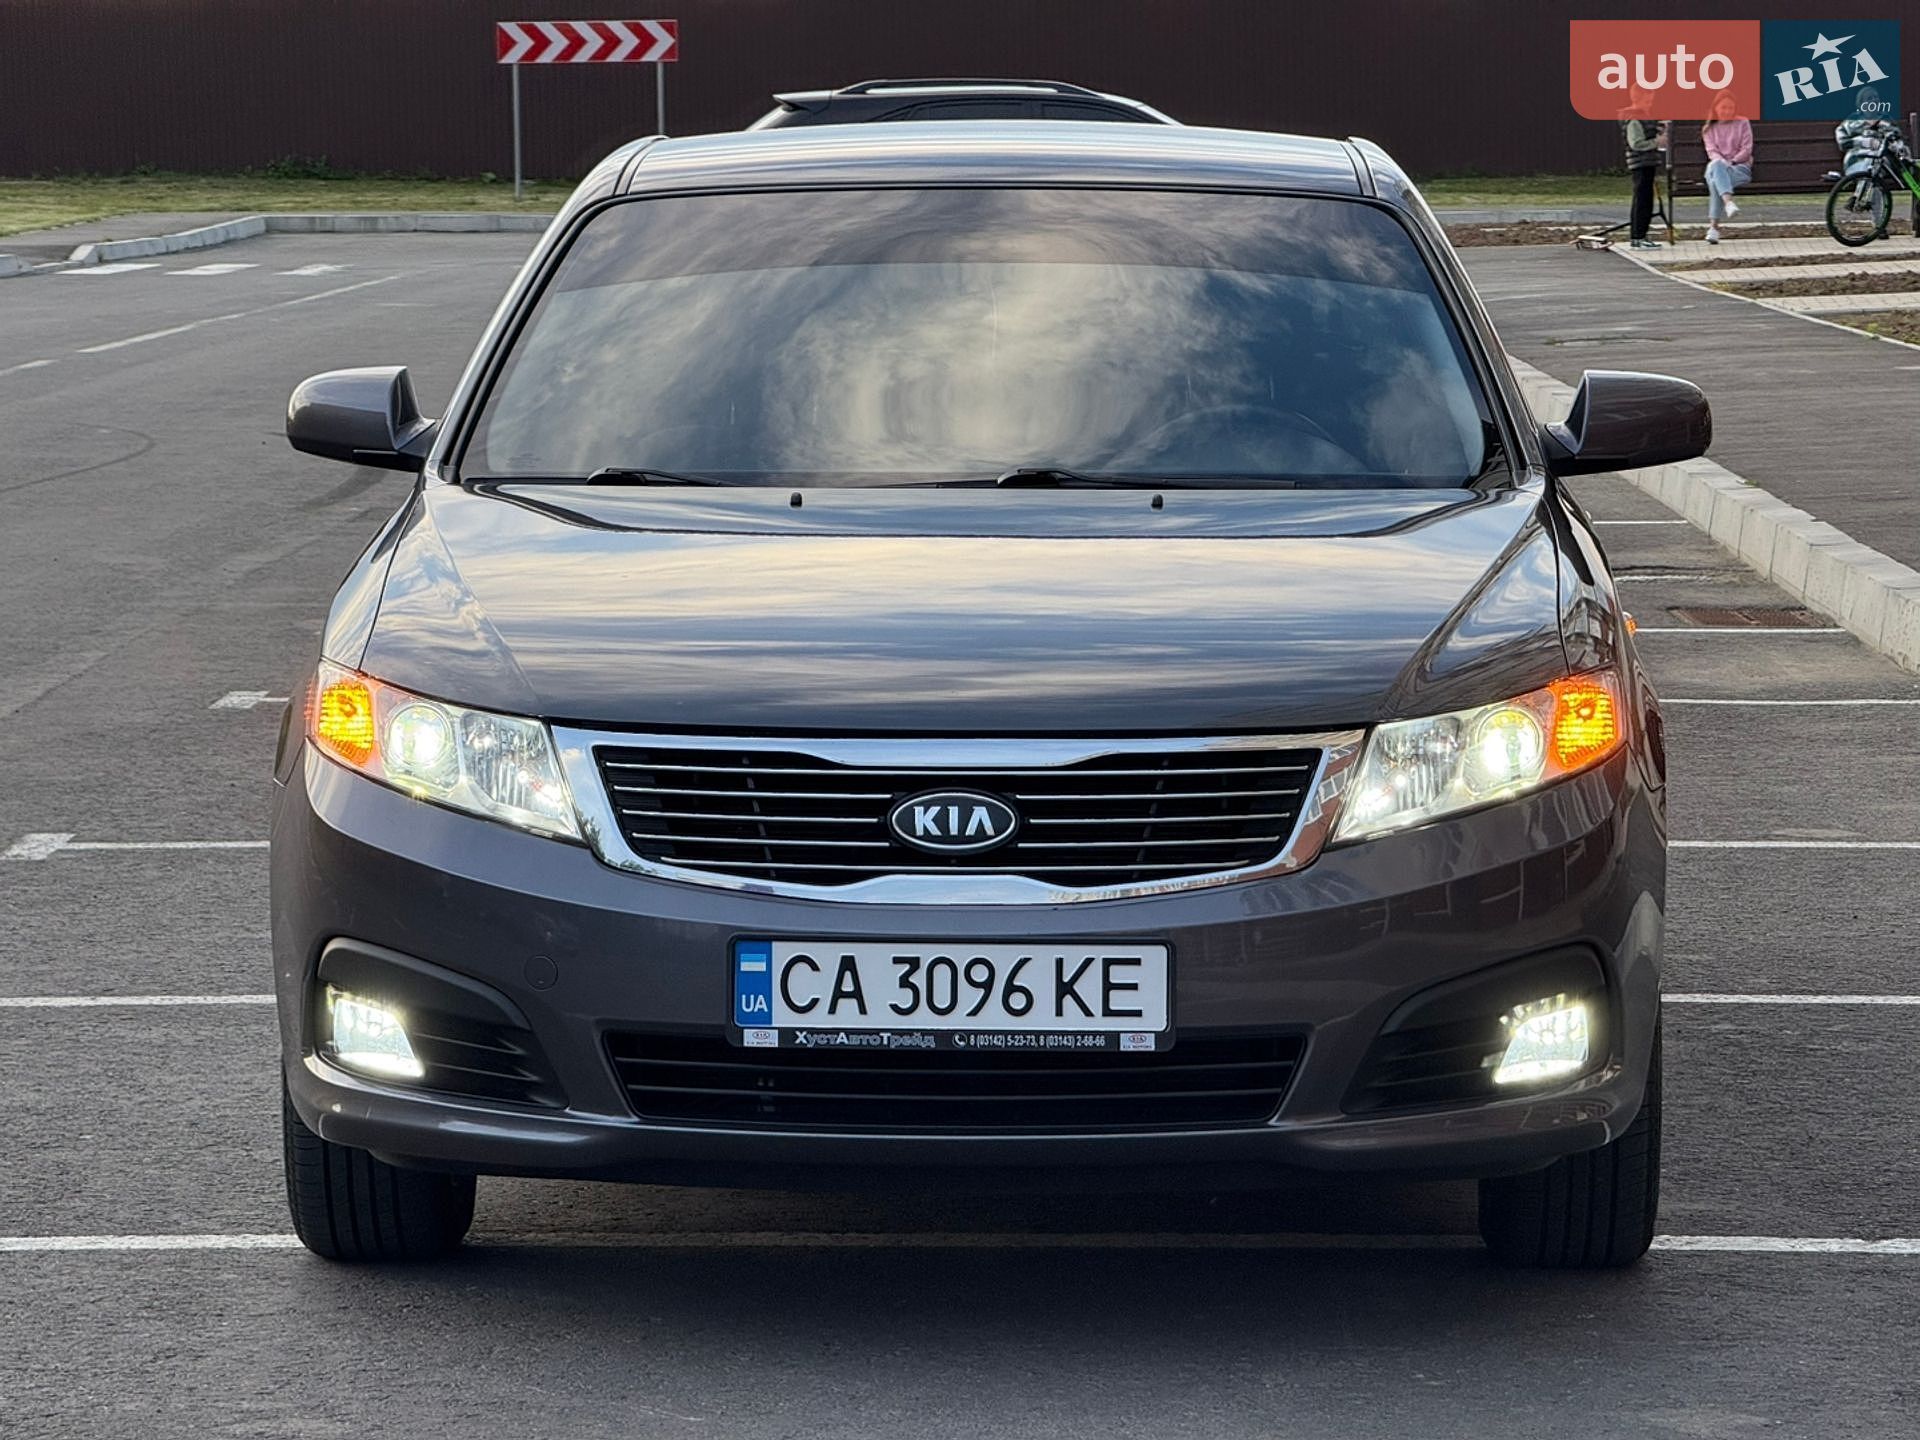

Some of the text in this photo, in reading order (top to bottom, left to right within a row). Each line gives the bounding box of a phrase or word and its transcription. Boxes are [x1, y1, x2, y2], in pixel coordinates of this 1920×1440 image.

[913, 806, 995, 836] KIA
[780, 954, 1143, 1018] CA 3096 KE
[742, 994, 768, 1013] UA
